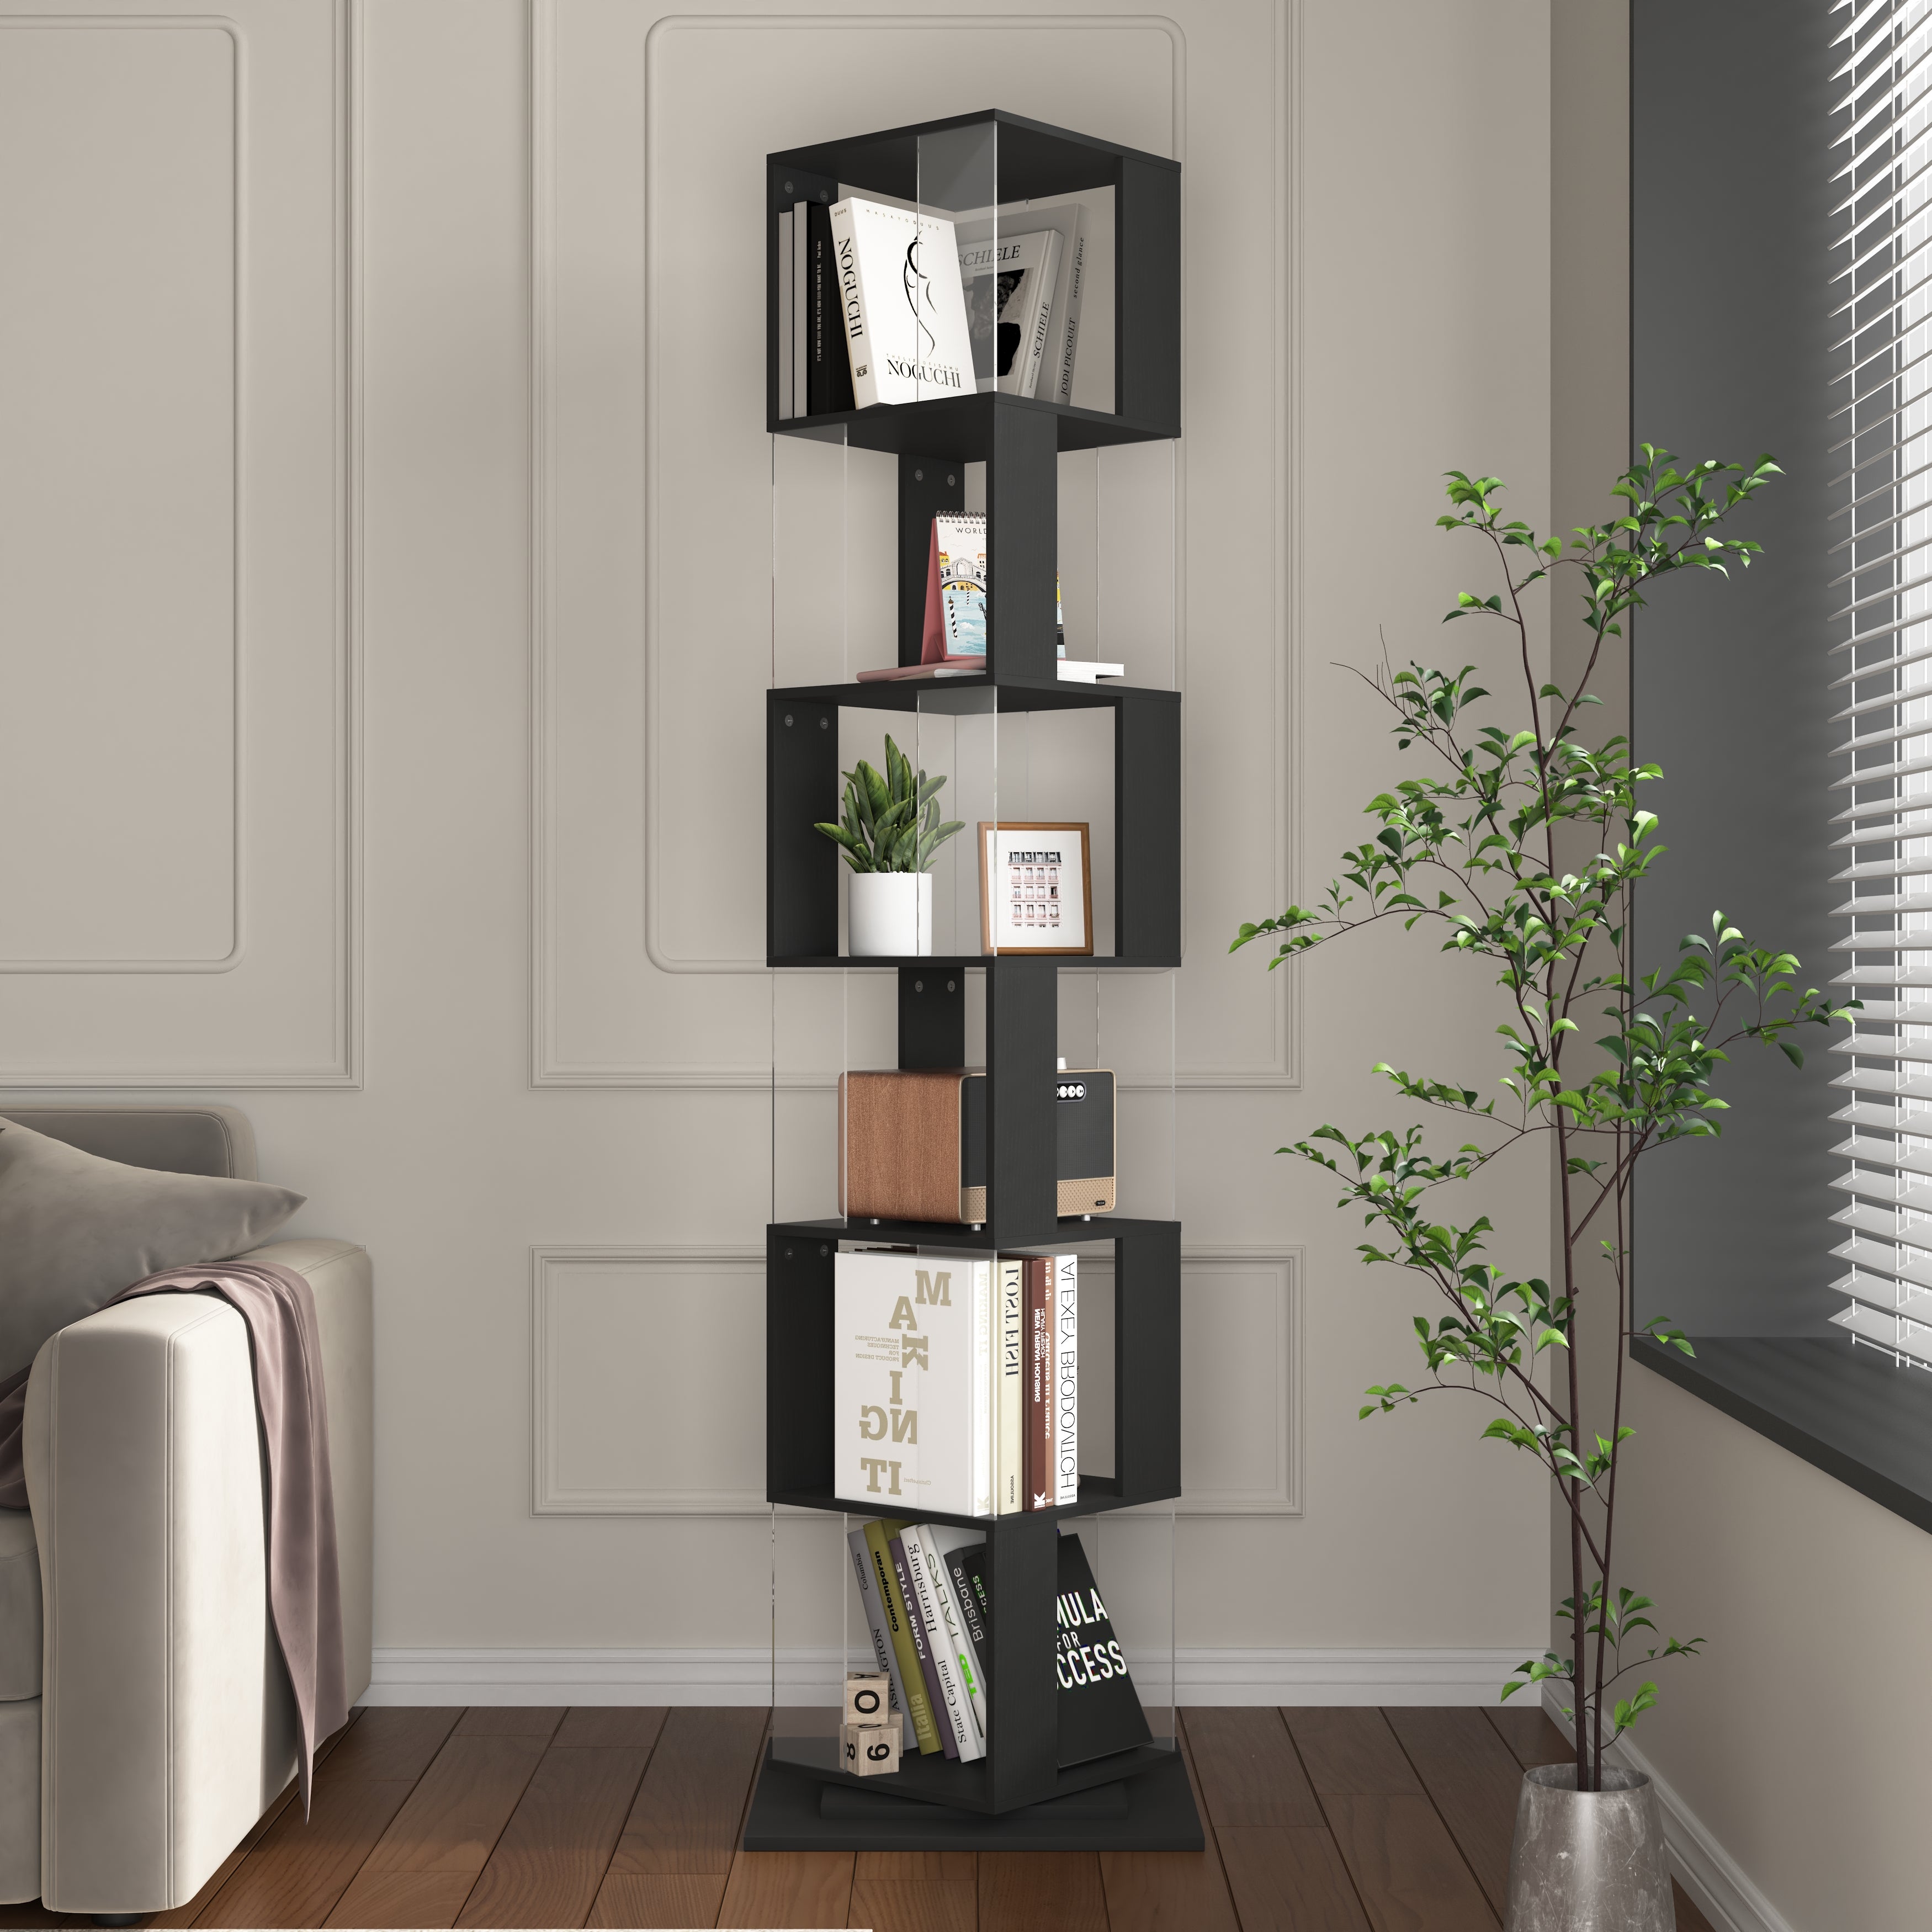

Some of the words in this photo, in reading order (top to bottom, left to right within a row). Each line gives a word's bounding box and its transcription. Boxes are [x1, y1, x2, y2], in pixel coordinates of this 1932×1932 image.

[835, 208, 847, 216] DUUS
[958, 245, 1021, 266] SCHIELE
[838, 237, 863, 339] NOGUCHI
[1033, 302, 1049, 358] SCHIELE
[1064, 317, 1075, 367] PICOULT
[887, 359, 962, 388] NOGUCHI
[1061, 369, 1070, 396] JODI
[856, 1553, 868, 1590] Columbia
[874, 1551, 899, 1632] Contemporan
[895, 1562, 912, 1611] STYLE
[908, 1543, 937, 1633] Harrisburg
[973, 1575, 987, 1613] CESS
[927, 1554, 958, 1644] TALKS
[954, 1568, 984, 1642] Brisbane
[909, 1615, 926, 1660] FORM
[938, 1660, 957, 1706] Capital
[1057, 1641, 1127, 1691] CCESS
[911, 1694, 932, 1740] Italia
[953, 1710, 967, 1743] State
